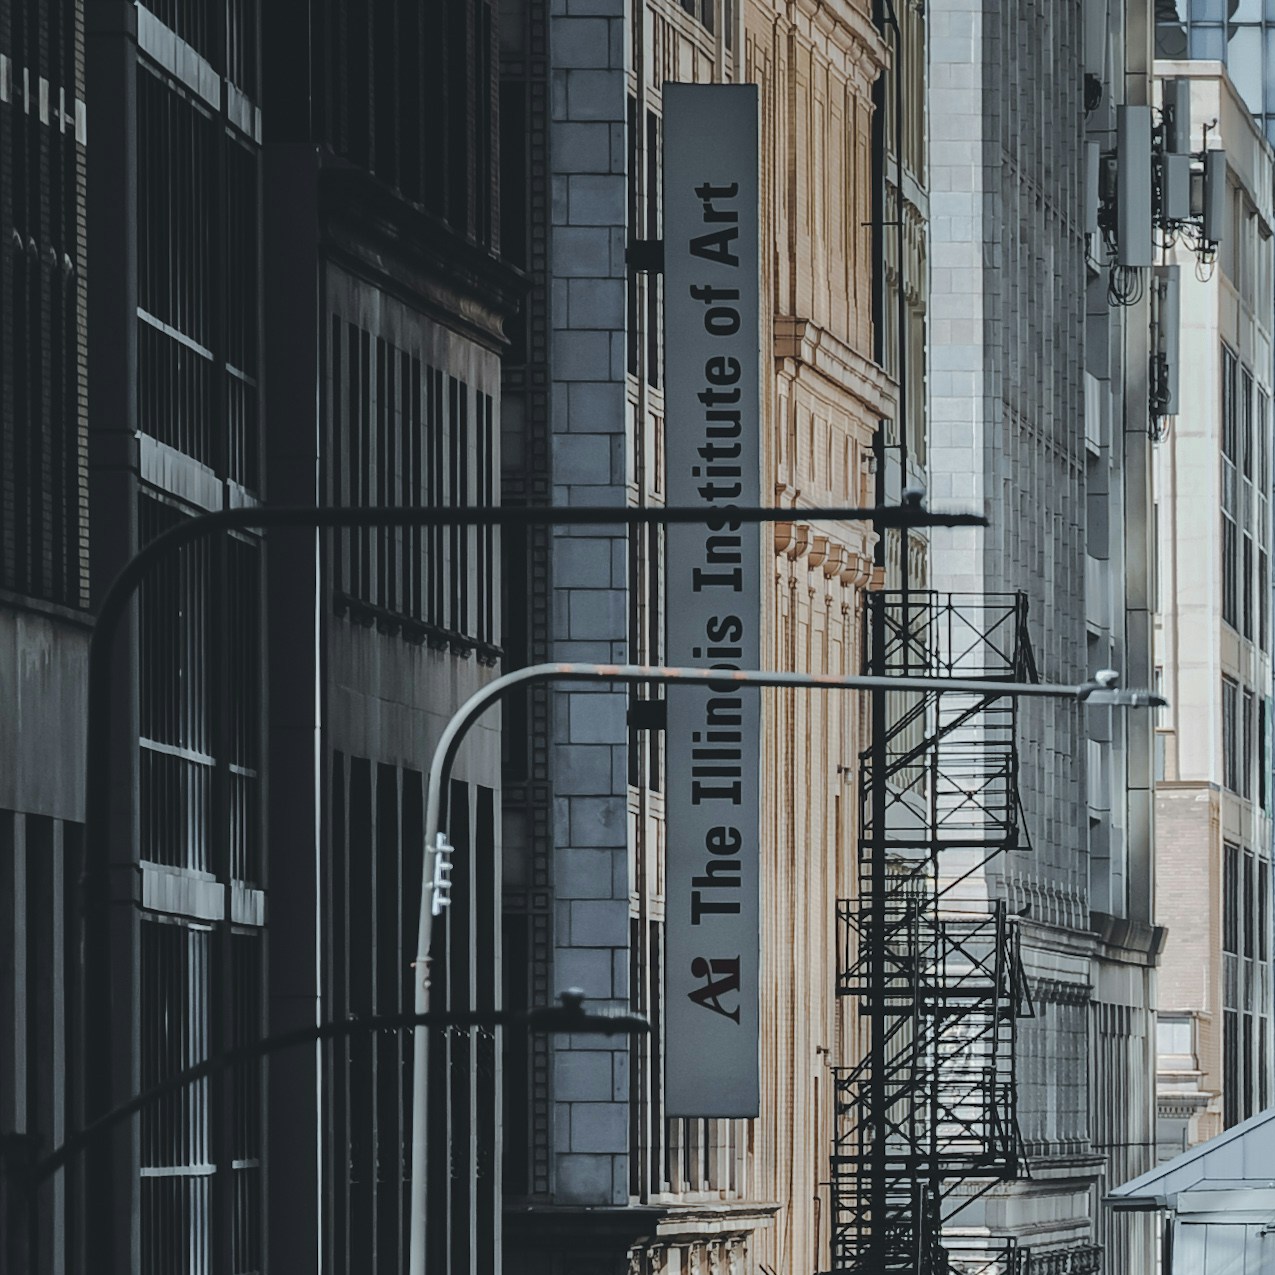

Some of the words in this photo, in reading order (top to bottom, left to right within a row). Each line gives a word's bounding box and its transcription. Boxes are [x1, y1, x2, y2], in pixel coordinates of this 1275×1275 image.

[691, 182, 742, 266] Art
[691, 285, 742, 337] of
[690, 356, 745, 592] Institute
[690, 616, 745, 805] Illinois
[691, 826, 742, 925] The
